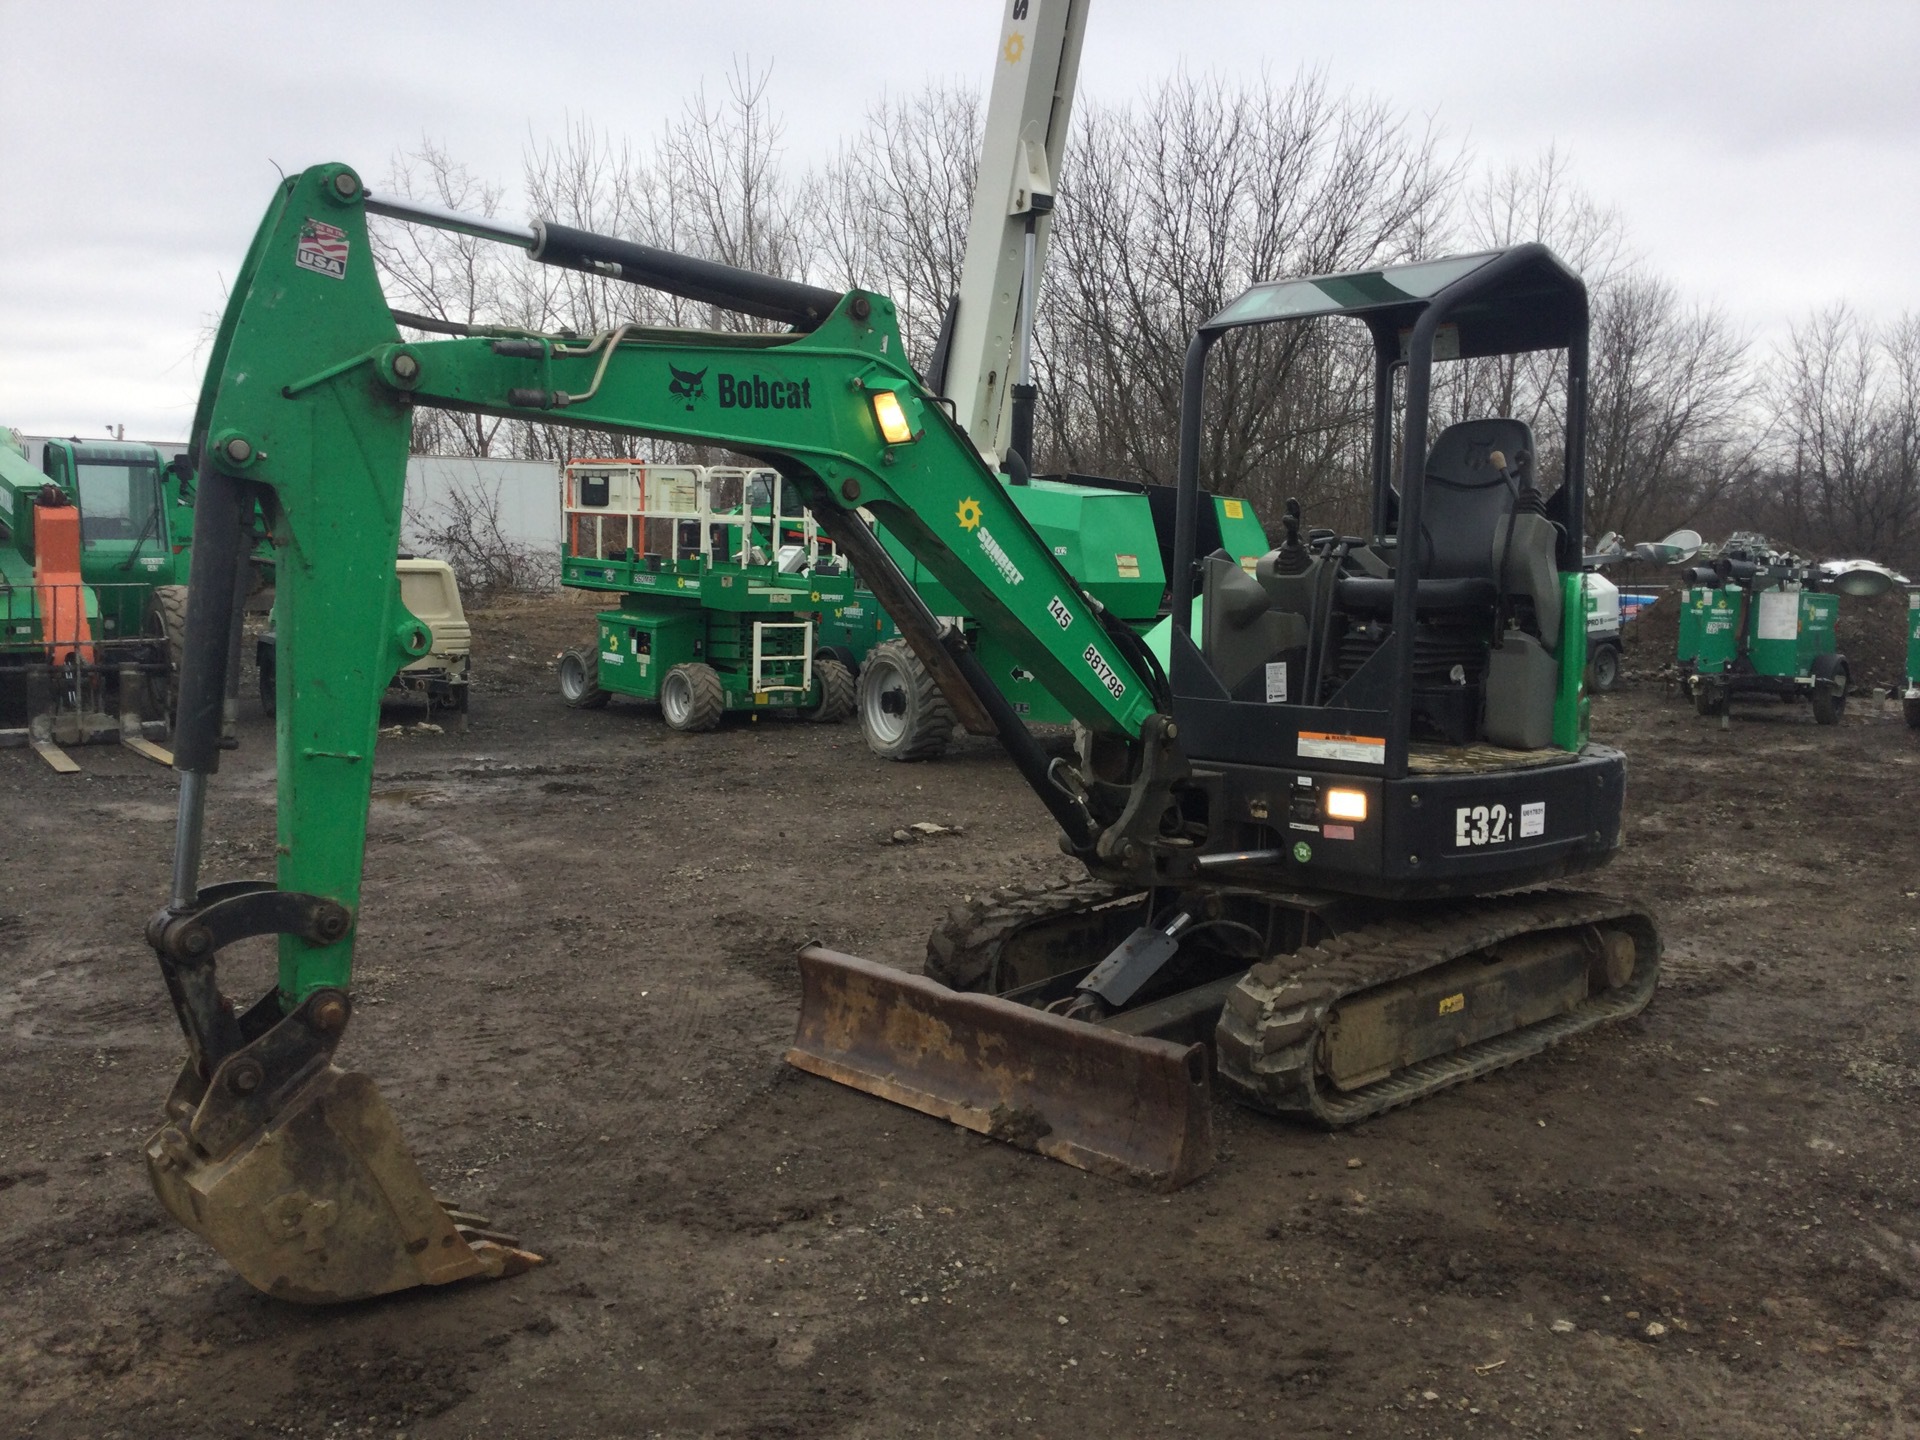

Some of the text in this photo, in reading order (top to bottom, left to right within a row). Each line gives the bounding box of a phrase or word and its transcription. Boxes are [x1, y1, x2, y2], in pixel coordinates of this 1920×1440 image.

[300, 250, 341, 273] USA
[718, 373, 812, 409] Bobcat
[977, 527, 1024, 586] SUNBELT
[1049, 599, 1072, 628] 145
[1084, 646, 1124, 699] 881798
[1456, 804, 1513, 847] E32i
